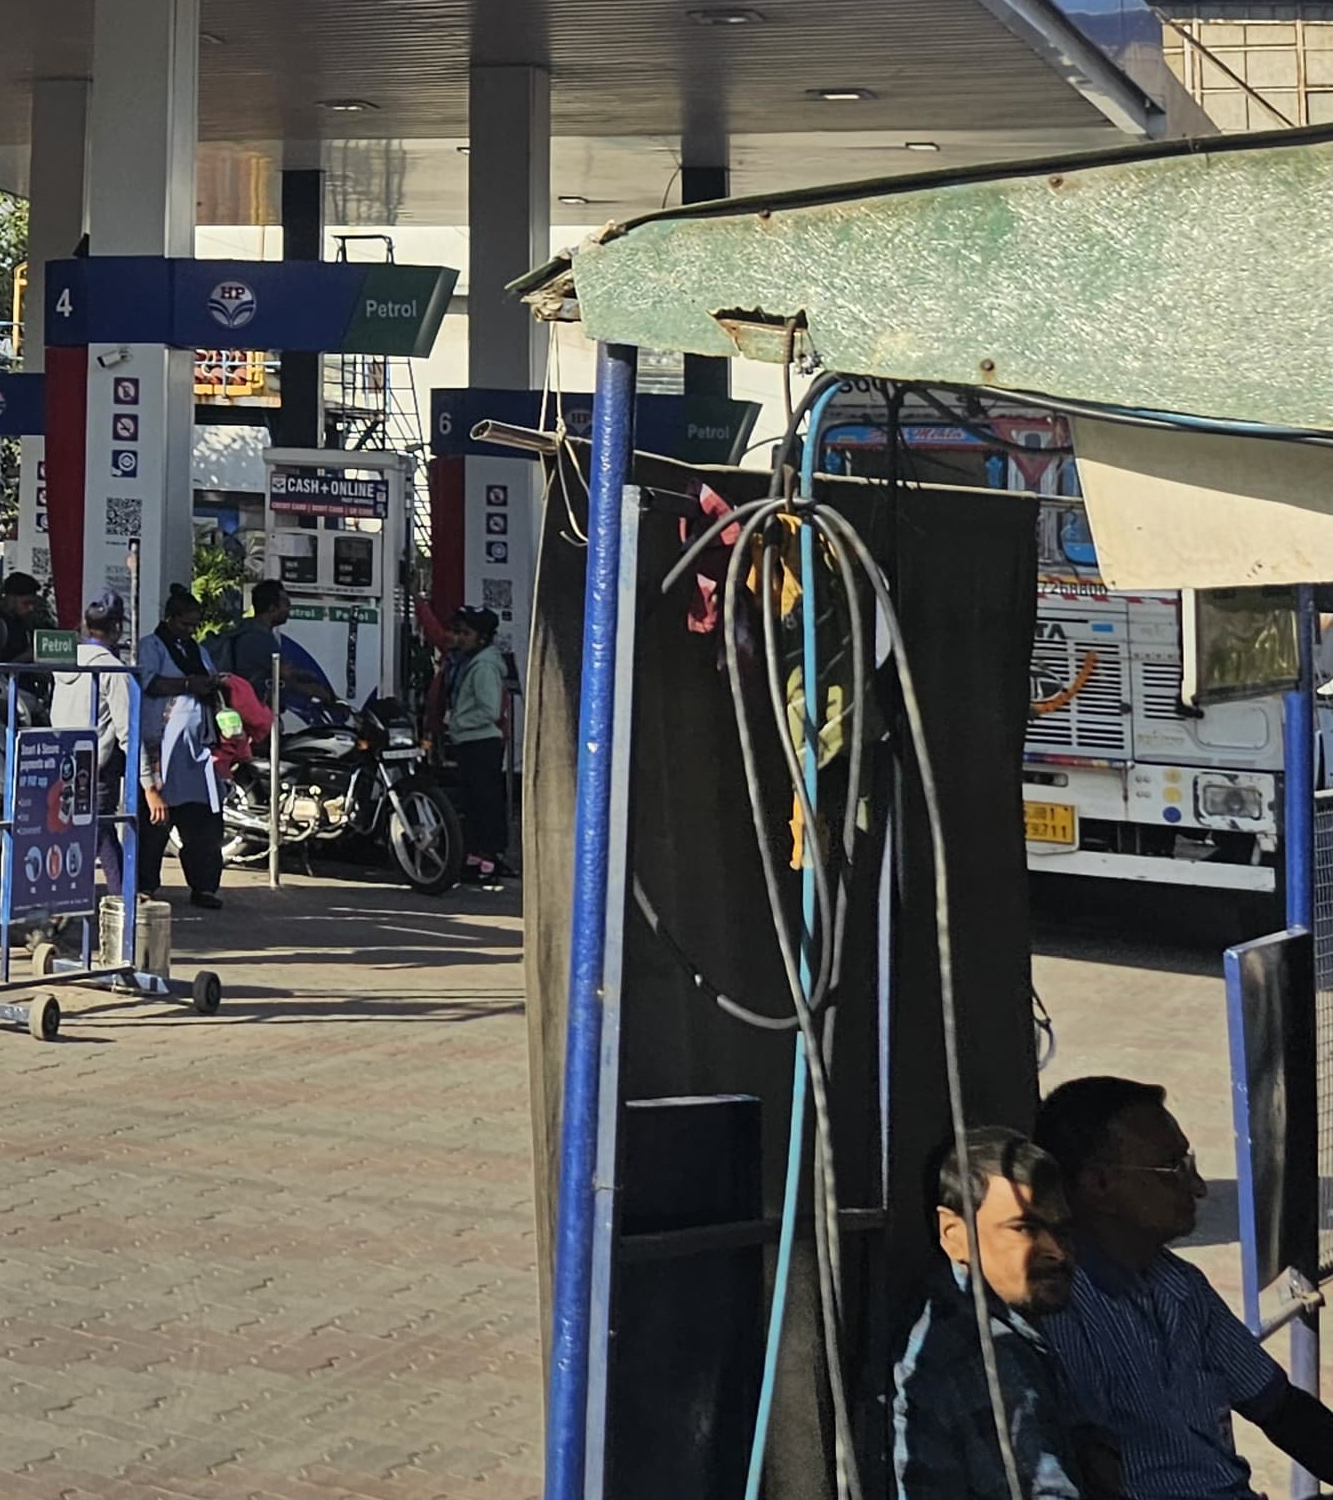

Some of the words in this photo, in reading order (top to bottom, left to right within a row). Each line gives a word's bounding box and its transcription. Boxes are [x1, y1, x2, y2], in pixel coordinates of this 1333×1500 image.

[221, 286, 245, 299] HP
[55, 288, 73, 317] 4
[366, 300, 416, 318] Petrol
[439, 412, 452, 435] 6
[687, 424, 730, 440] Petrol
[289, 609, 315, 617] etrol
[41, 637, 72, 652] Petrol
